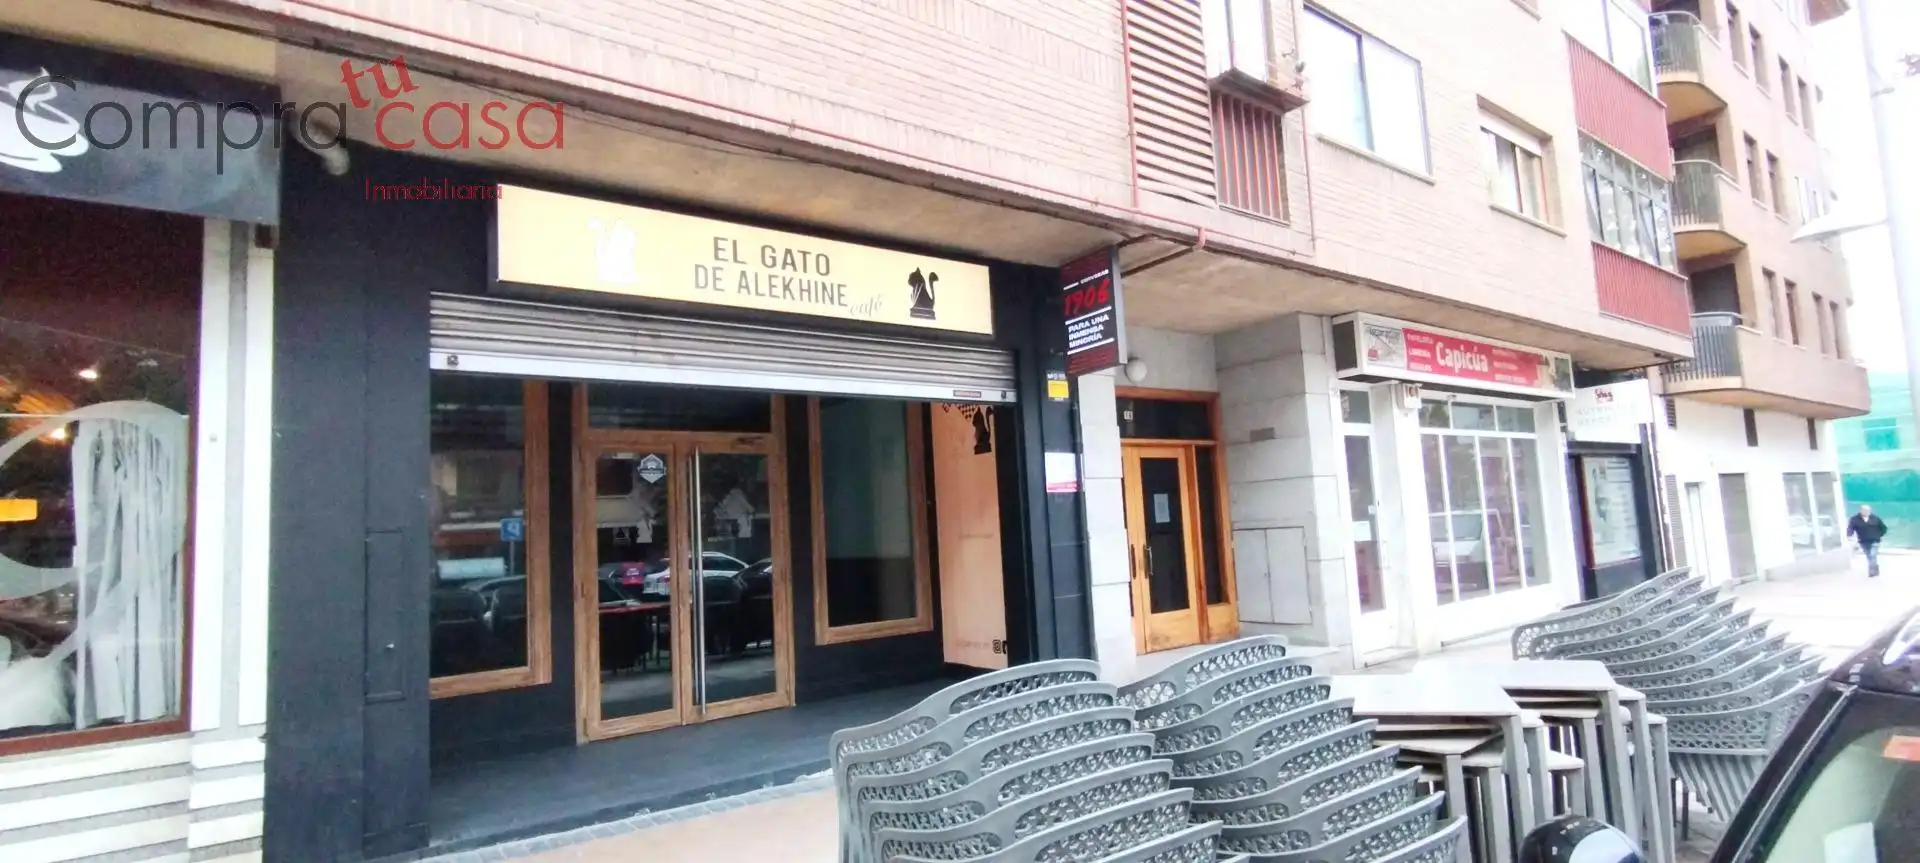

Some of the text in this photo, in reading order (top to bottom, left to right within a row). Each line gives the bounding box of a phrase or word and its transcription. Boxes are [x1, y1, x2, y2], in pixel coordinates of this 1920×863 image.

[713, 236, 831, 277] EL GATO
[694, 263, 725, 292] DE
[737, 270, 848, 307] ALEKHINE
[1064, 278, 1111, 316] 1906
[1068, 314, 1110, 333] PARA UNA
[1068, 324, 1104, 341] INMENSA
[1435, 341, 1489, 373] Capicúa
